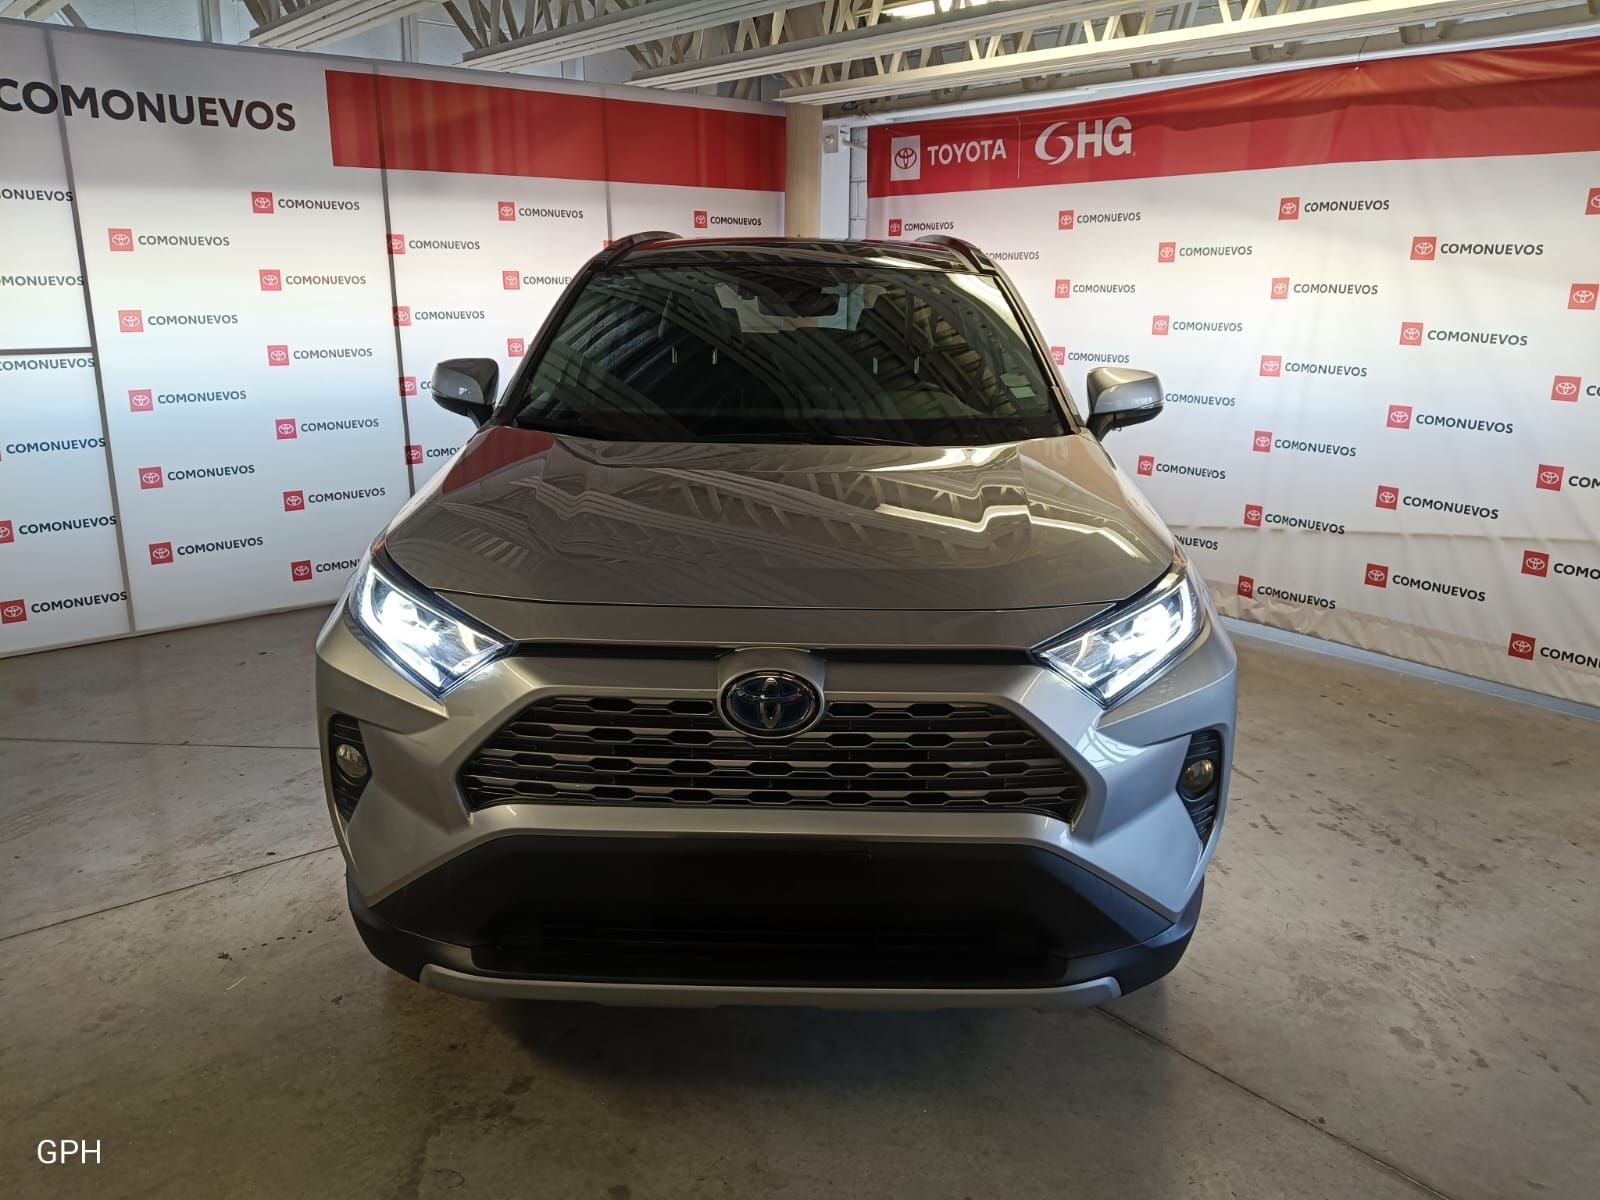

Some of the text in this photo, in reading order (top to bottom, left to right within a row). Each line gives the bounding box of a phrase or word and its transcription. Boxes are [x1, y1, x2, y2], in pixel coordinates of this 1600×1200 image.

[0, 78, 296, 132] COMONUEVOS
[927, 138, 1007, 166] TOYOTA
[0, 188, 73, 202] ONUEVOS
[277, 198, 361, 212] COMONUEVOS
[1304, 199, 1390, 213] COMONUEVOS
[518, 207, 584, 219] COMONUEVOS
[1077, 212, 1141, 224] COMONUEVOS
[709, 215, 762, 226] COMONUEVOS
[904, 221, 954, 231] COMONUEVOS
[137, 235, 230, 247] COMONUEVOS
[408, 239, 480, 250] COMONUEVOS
[986, 251, 1040, 261] OMONUEVOS
[1179, 244, 1252, 257] COMONUEVOS
[1440, 243, 1544, 256] COMONUEVOS
[0, 275, 84, 286] MONUEVOS
[285, 275, 367, 286] COMONUEVOS
[1073, 283, 1136, 294] COMONUEVOS
[1293, 282, 1378, 295] COMONUEVOS
[147, 314, 239, 326] COMONUEVOS
[414, 309, 485, 321] COMONUEVOS
[1172, 321, 1243, 333] COMONUEVOS
[1427, 329, 1528, 347] COMONUEVOS
[292, 347, 373, 360] COMONUEVOS
[1067, 351, 1130, 364] COMONUEVOS
[1284, 361, 1368, 378] COMONUEVOS
[157, 390, 247, 405] COMONUEVOS
[1165, 392, 1236, 407] COMONUEVOS
[300, 418, 380, 433] COMONUEVOS
[1415, 413, 1514, 434] COMONUEVOS
[6, 437, 106, 454] COMONUEVOS
[1274, 438, 1357, 457] COMONUEVOS
[167, 464, 256, 482] COMONUEVOS
[1155, 462, 1226, 480] COMONUEVOS
[308, 487, 386, 504] COMONUEVOS
[1402, 495, 1500, 520] COMONUEVOS
[18, 515, 117, 536] COMONUEVOS
[1264, 512, 1346, 535] COMONUEVOS
[177, 536, 264, 556] COMONUEVOS
[1174, 534, 1219, 551] NUEVOS
[1392, 573, 1487, 602] COMONUEVOS
[31, 591, 128, 614] COMONUEVOS
[1257, 584, 1337, 610] COMONUEVOS
